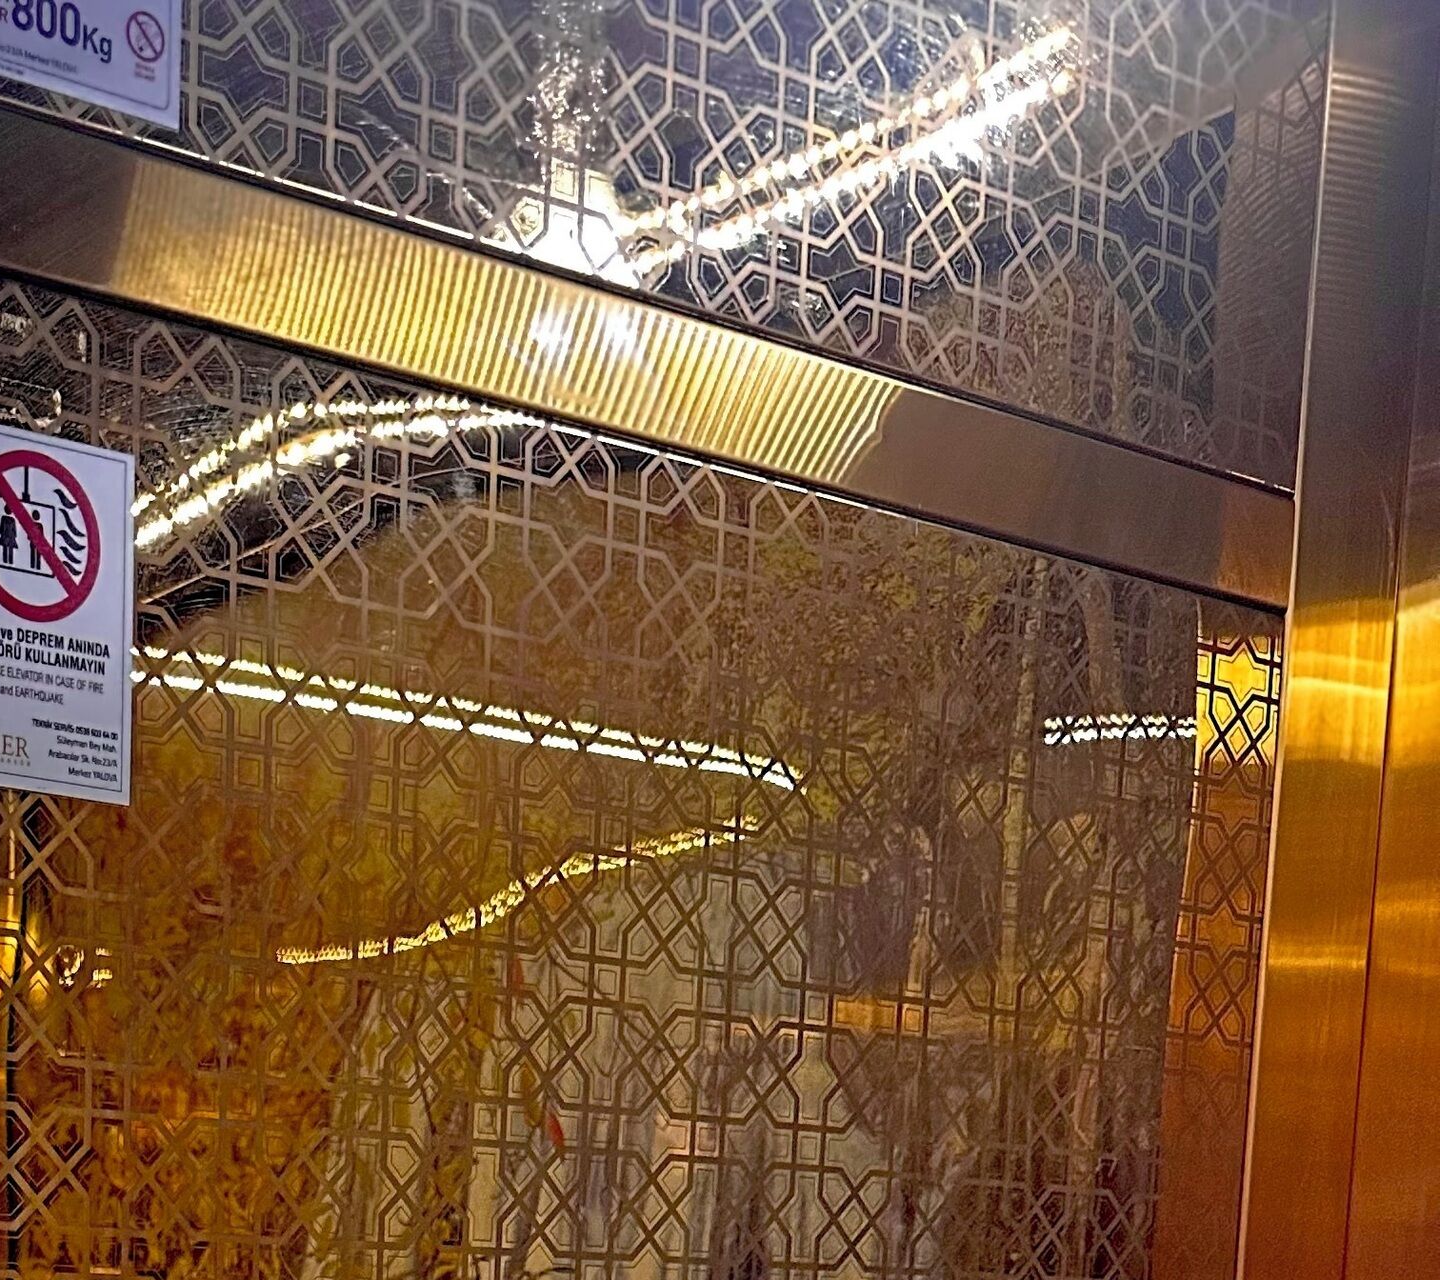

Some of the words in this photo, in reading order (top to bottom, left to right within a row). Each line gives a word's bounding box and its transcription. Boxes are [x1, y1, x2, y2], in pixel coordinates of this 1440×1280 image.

[0, 627, 13, 640] ve
[17, 628, 64, 650] DEPREM
[67, 638, 110, 658] ANINDA
[25, 647, 105, 675] KULLANMAYIN
[7, 666, 43, 683] ELEVATOR
[45, 674, 54, 685] IN
[55, 675, 75, 689] CASE
[76, 679, 87, 691] OF
[88, 681, 104, 694] FIRE
[0, 684, 13, 696] and
[15, 686, 64, 705] EARTHQUAKE
